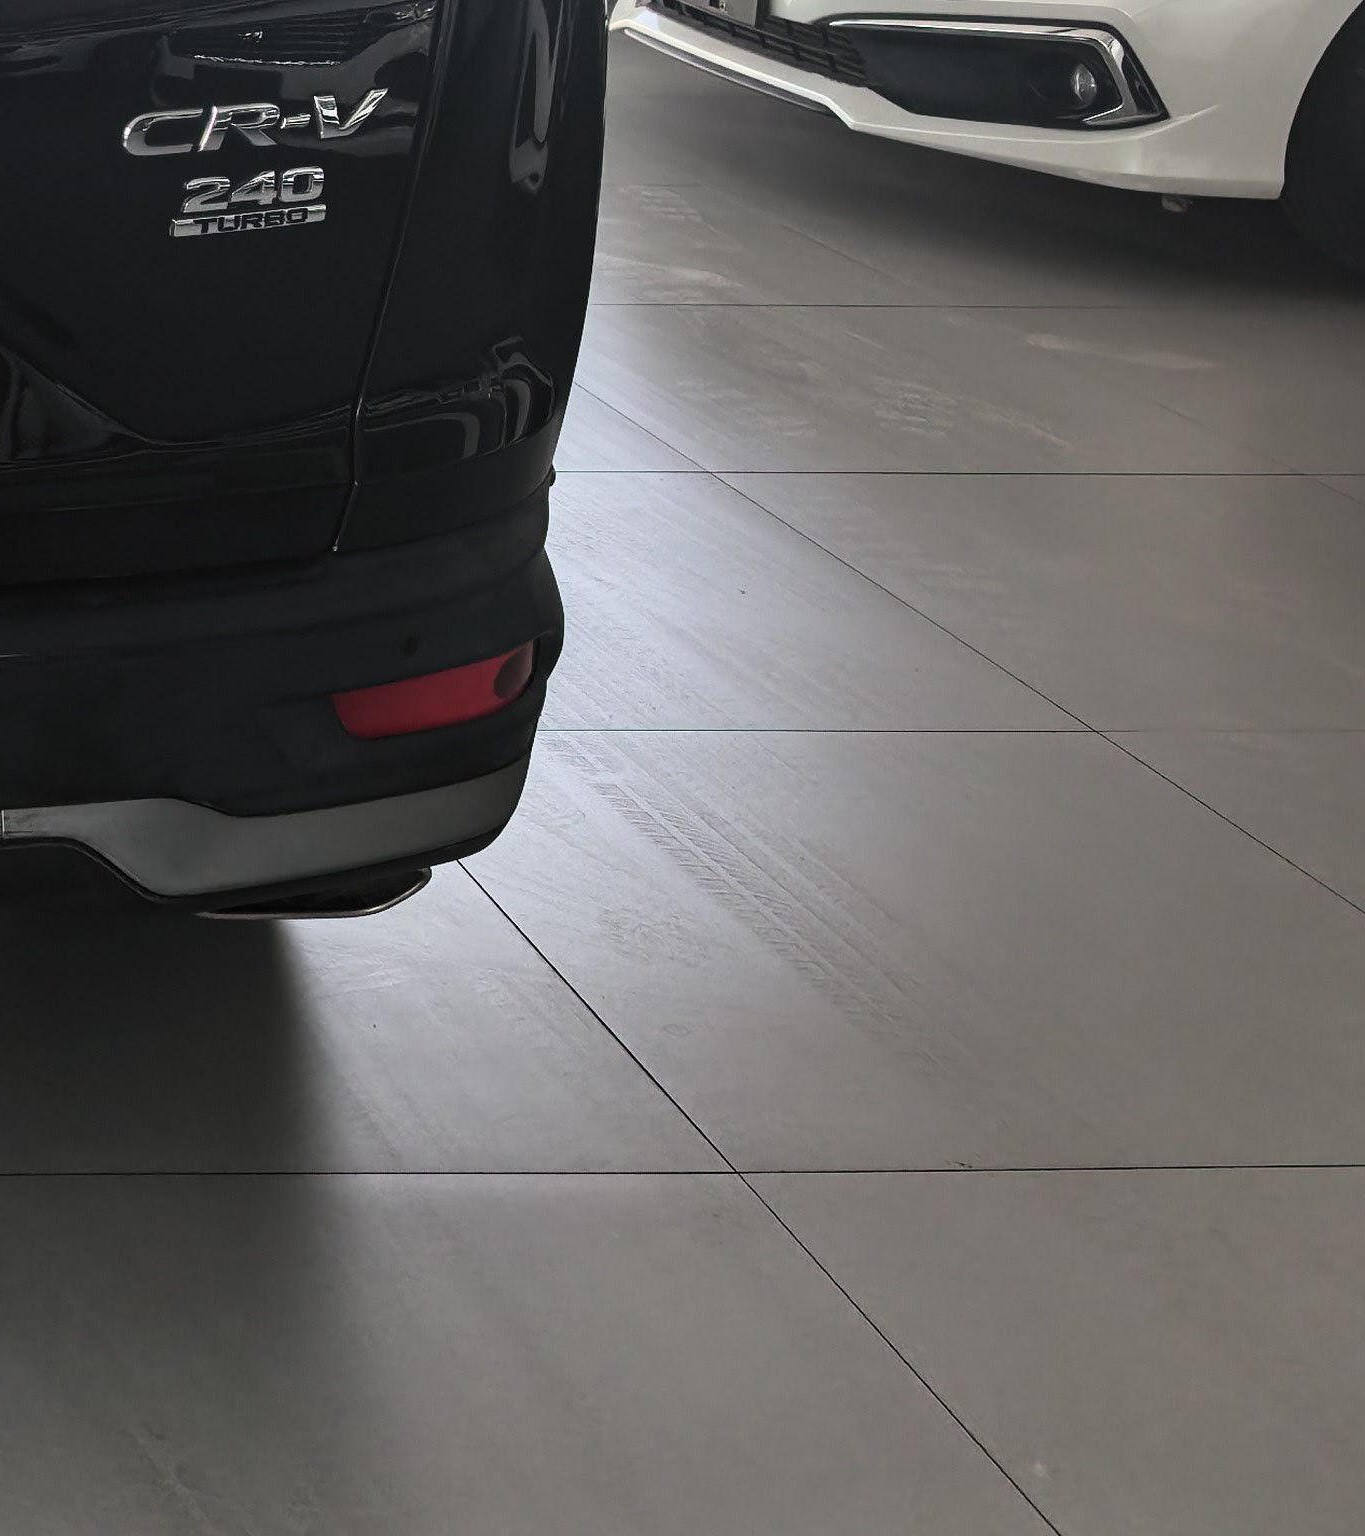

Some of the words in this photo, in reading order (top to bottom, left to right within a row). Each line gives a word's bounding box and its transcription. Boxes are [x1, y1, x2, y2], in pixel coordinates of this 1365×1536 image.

[122, 87, 389, 156] CR-V
[182, 166, 325, 214] 240
[192, 206, 310, 235] TURBO
